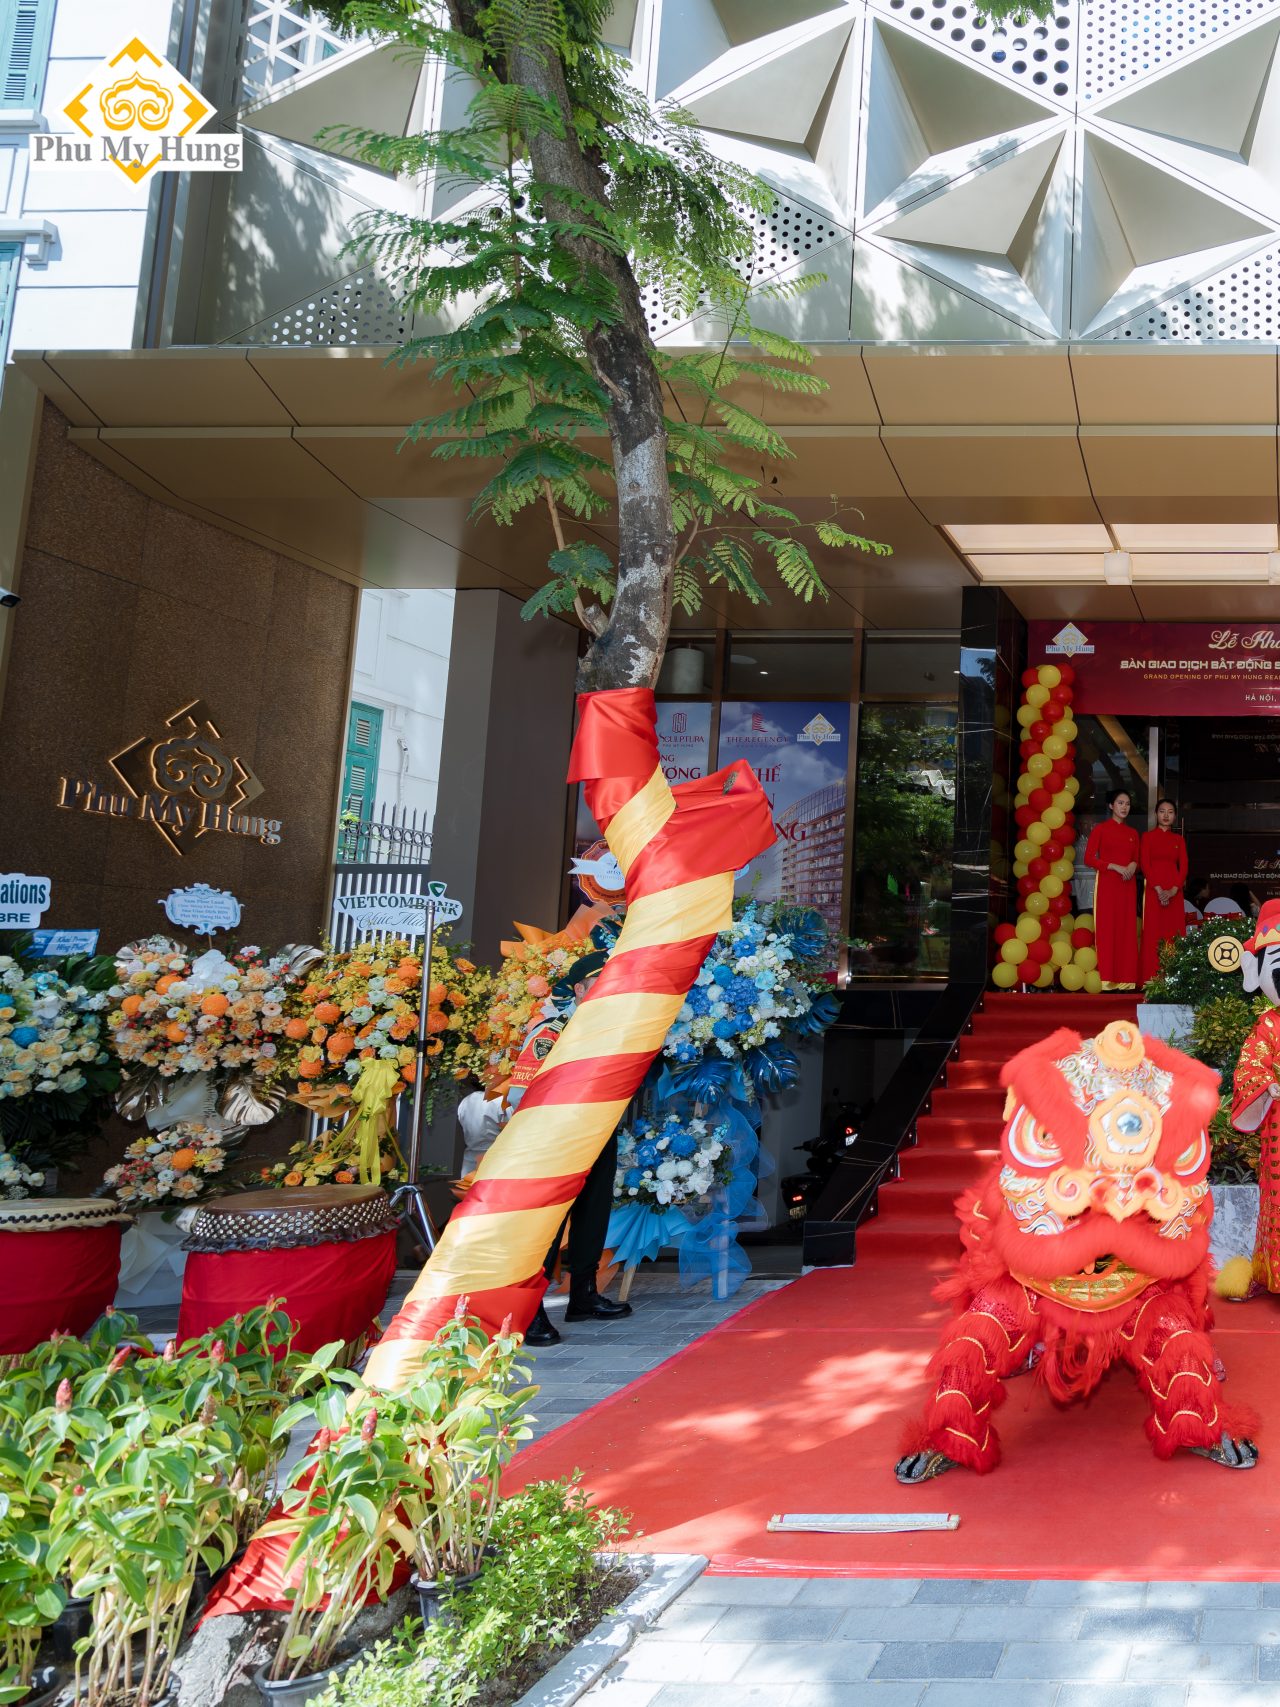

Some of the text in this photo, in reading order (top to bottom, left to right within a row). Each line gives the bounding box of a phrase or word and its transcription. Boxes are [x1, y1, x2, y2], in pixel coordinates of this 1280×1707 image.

[1208, 630, 1240, 650] Lễ
[1120, 658, 1146, 669] SÀN
[1148, 661, 1177, 669] GIAO
[1179, 661, 1208, 672] DỊCH
[1211, 657, 1235, 669] BẤT
[1236, 658, 1272, 672] ĐỘNG
[1245, 693, 1256, 701] HÀ
[57, 777, 282, 844] Phu My Hung
[357, 912, 394, 928] Chúc
